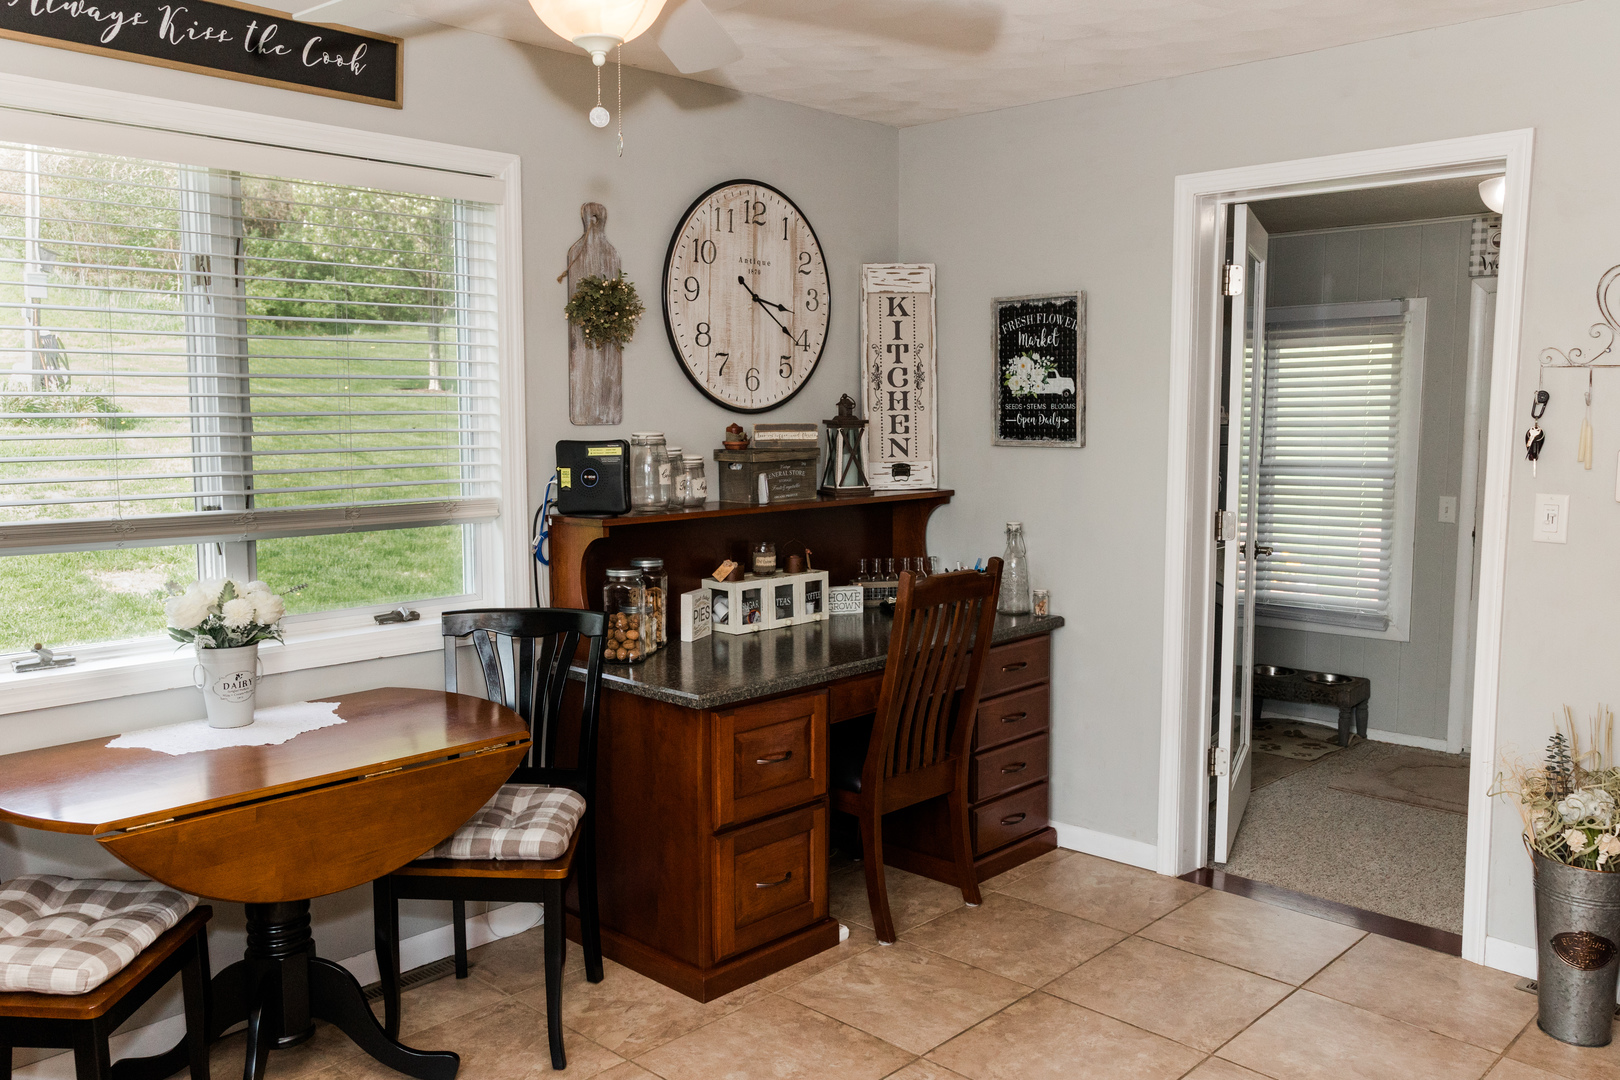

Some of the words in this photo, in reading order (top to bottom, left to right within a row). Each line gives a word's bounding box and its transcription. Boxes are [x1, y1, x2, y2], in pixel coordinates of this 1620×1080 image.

[158, 5, 234, 46] Kiss
[244, 19, 292, 56] the
[301, 36, 368, 76] Cook
[714, 207, 734, 234] 11
[743, 199, 767, 226] 12
[782, 217, 789, 240] 1
[692, 238, 717, 265] 10
[738, 256, 771, 267] Antique
[798, 251, 812, 276] 2
[683, 276, 700, 302] 9
[805, 288, 819, 312] 3
[694, 322, 712, 347] 8
[1001, 314, 1036, 335] FRESH
[795, 329, 811, 352] 4
[1018, 327, 1060, 348] Market
[714, 352, 730, 377] 7
[778, 355, 793, 379] 5
[745, 367, 761, 392] 6
[886, 296, 911, 459] KITCHEN
[1016, 413, 1036, 427] Open
[1038, 413, 1062, 429] Daily
[767, 470, 788, 479] ENERAL
[789, 469, 806, 477] STORE
[776, 597, 791, 606] TEAS
[828, 602, 861, 611] GROWN
[829, 591, 861, 603] HOME
[693, 605, 711, 625] PIES
[223, 677, 253, 690] DAIRY
